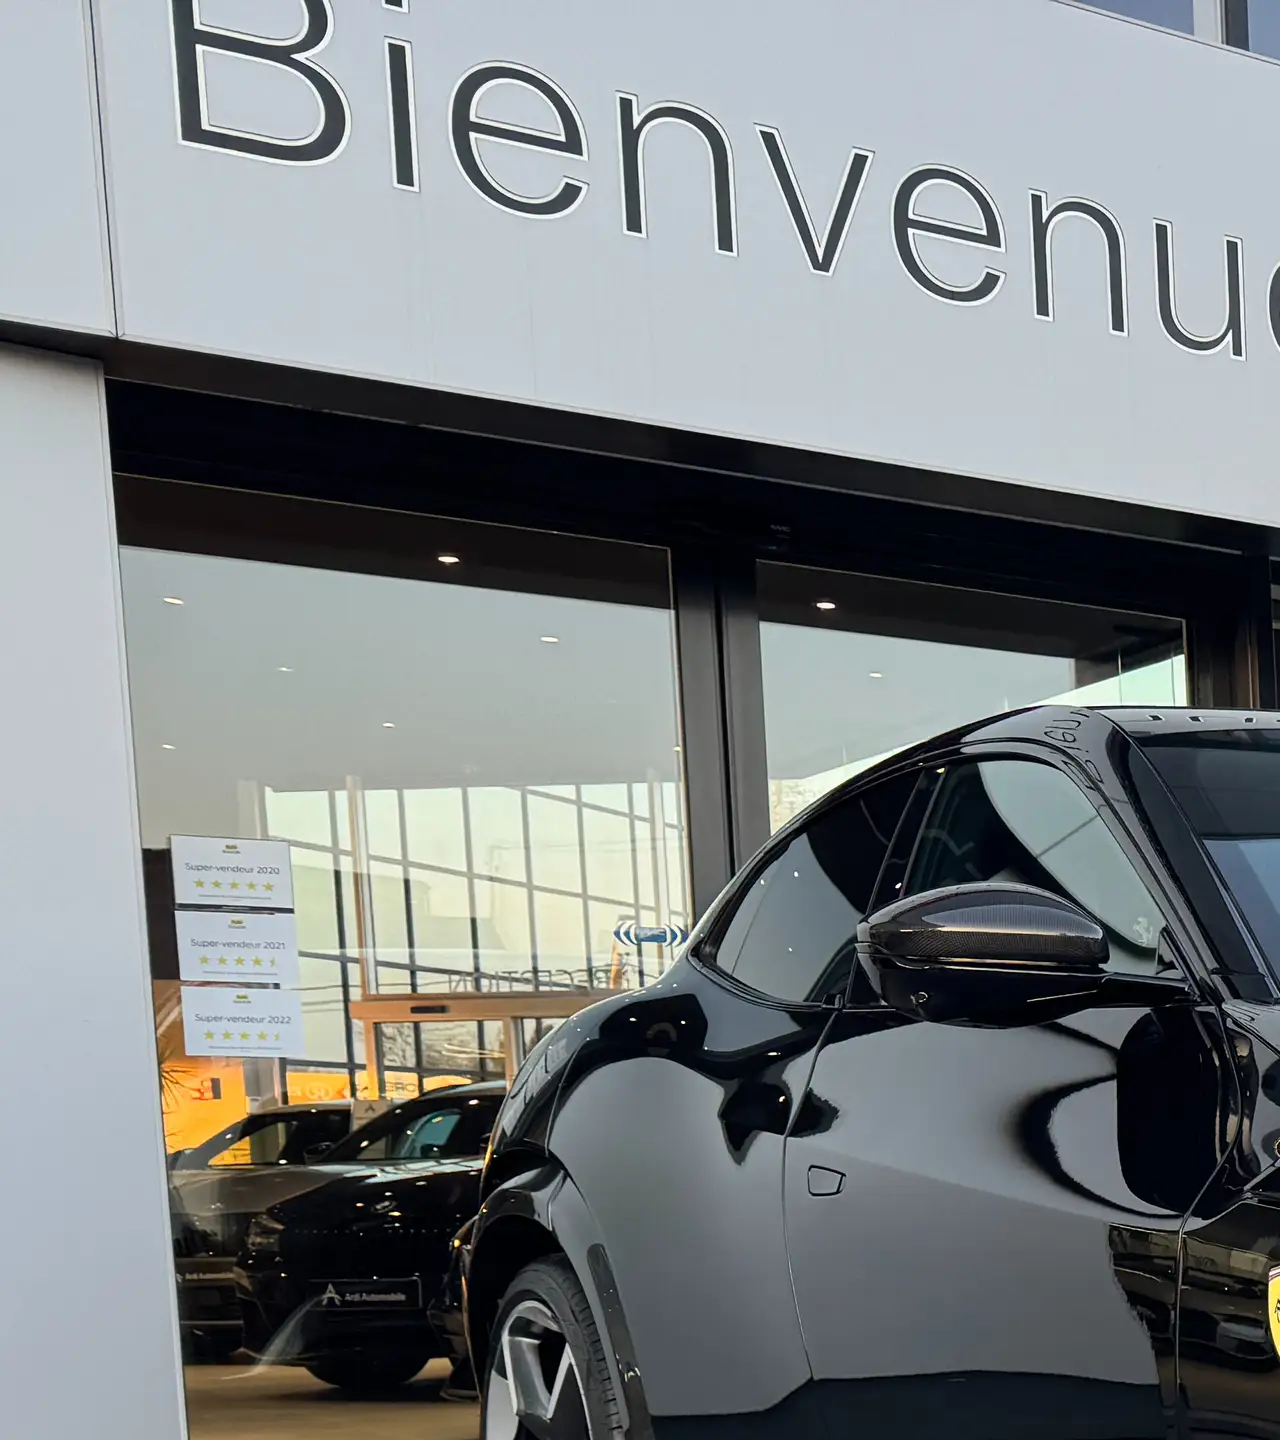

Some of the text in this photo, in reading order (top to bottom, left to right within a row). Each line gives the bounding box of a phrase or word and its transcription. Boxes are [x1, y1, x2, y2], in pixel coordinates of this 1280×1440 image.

[184, 862, 280, 875] Super-vendeur 2020
[190, 938, 286, 950] Super-vendeur 2021
[194, 1013, 292, 1025] Super-vendeur 2022
